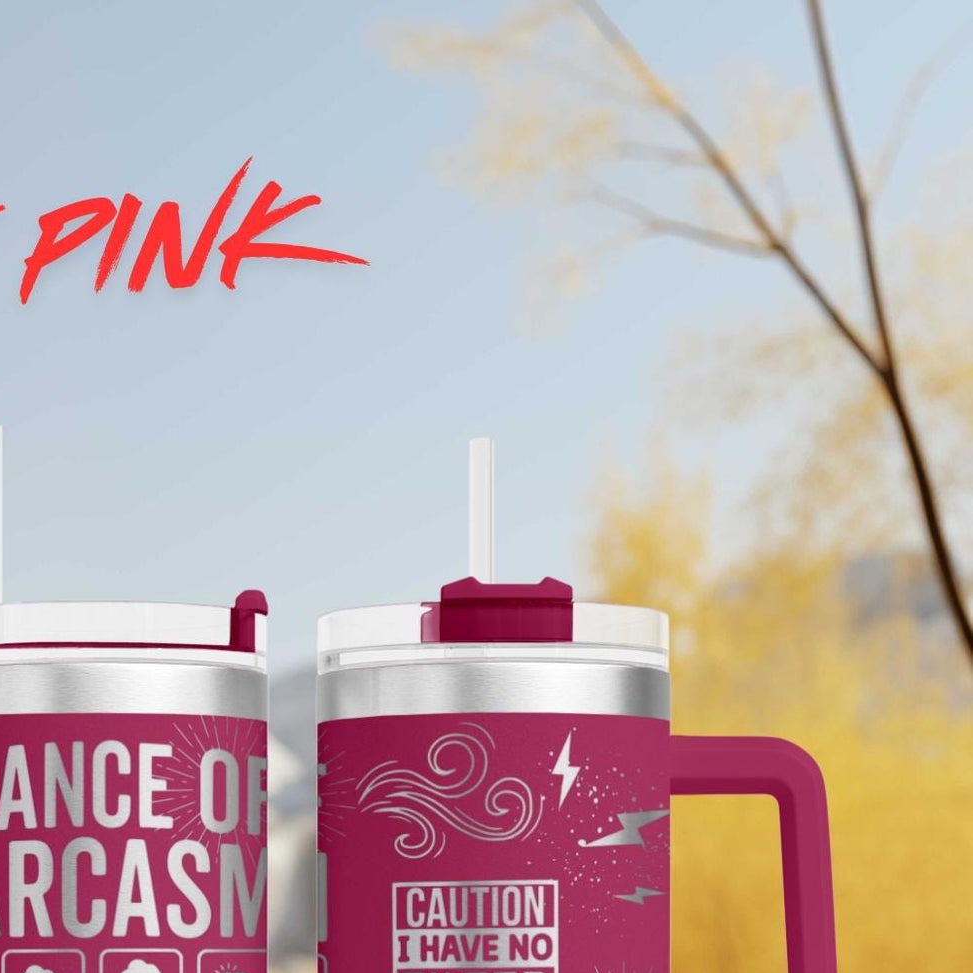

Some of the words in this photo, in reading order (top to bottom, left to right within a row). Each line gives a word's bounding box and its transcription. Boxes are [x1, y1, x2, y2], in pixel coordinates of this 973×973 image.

[406, 886, 544, 928] CAUTION
[398, 936, 410, 962] I
[420, 934, 498, 962] HAVE
[509, 933, 552, 961] NO
